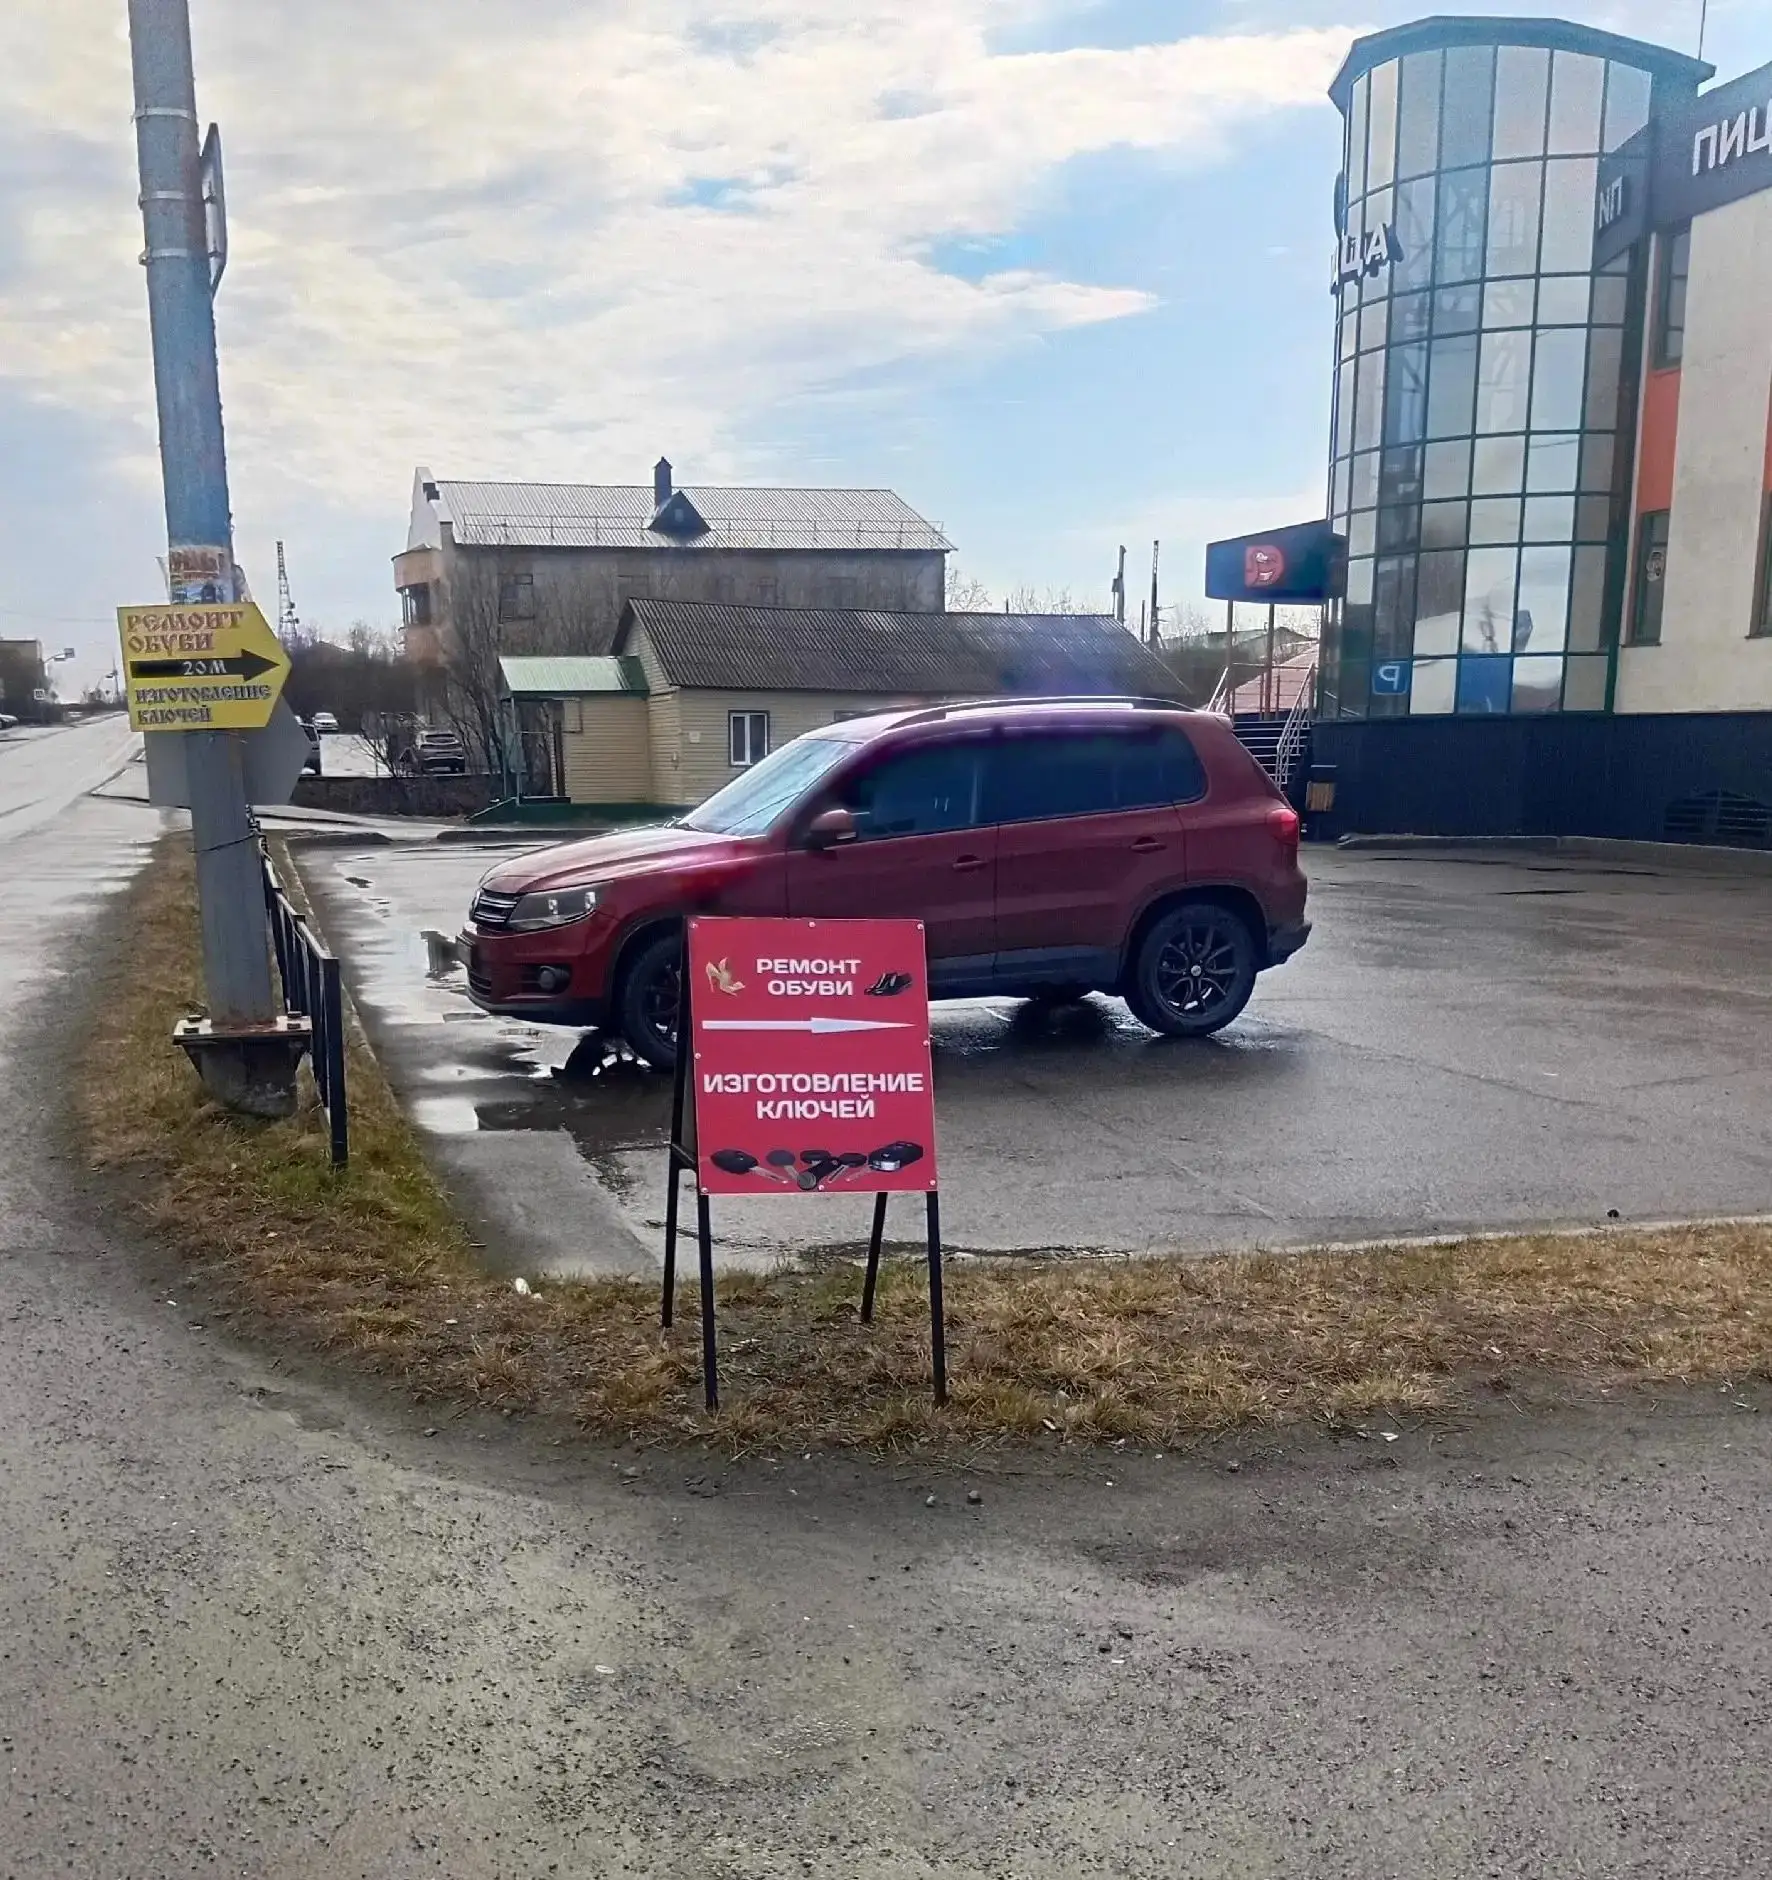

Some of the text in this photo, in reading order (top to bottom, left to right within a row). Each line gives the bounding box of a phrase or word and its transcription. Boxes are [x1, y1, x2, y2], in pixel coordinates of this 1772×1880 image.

[1692, 98, 1772, 176] ПИЦ
[127, 611, 244, 633] РЕМОНТ
[127, 633, 215, 656] ОБУВИ
[135, 684, 272, 704] ИЗГОТОВЛЕНИЕ
[137, 704, 212, 725] КЛЮЧЕЙ
[756, 958, 862, 975] РЕМОНТ
[767, 980, 853, 996] ОБУВИ
[703, 1073, 924, 1094] ИЗГОТОВЛЕНИЕ
[756, 1094, 875, 1120] КЛЮЧЕЙ
